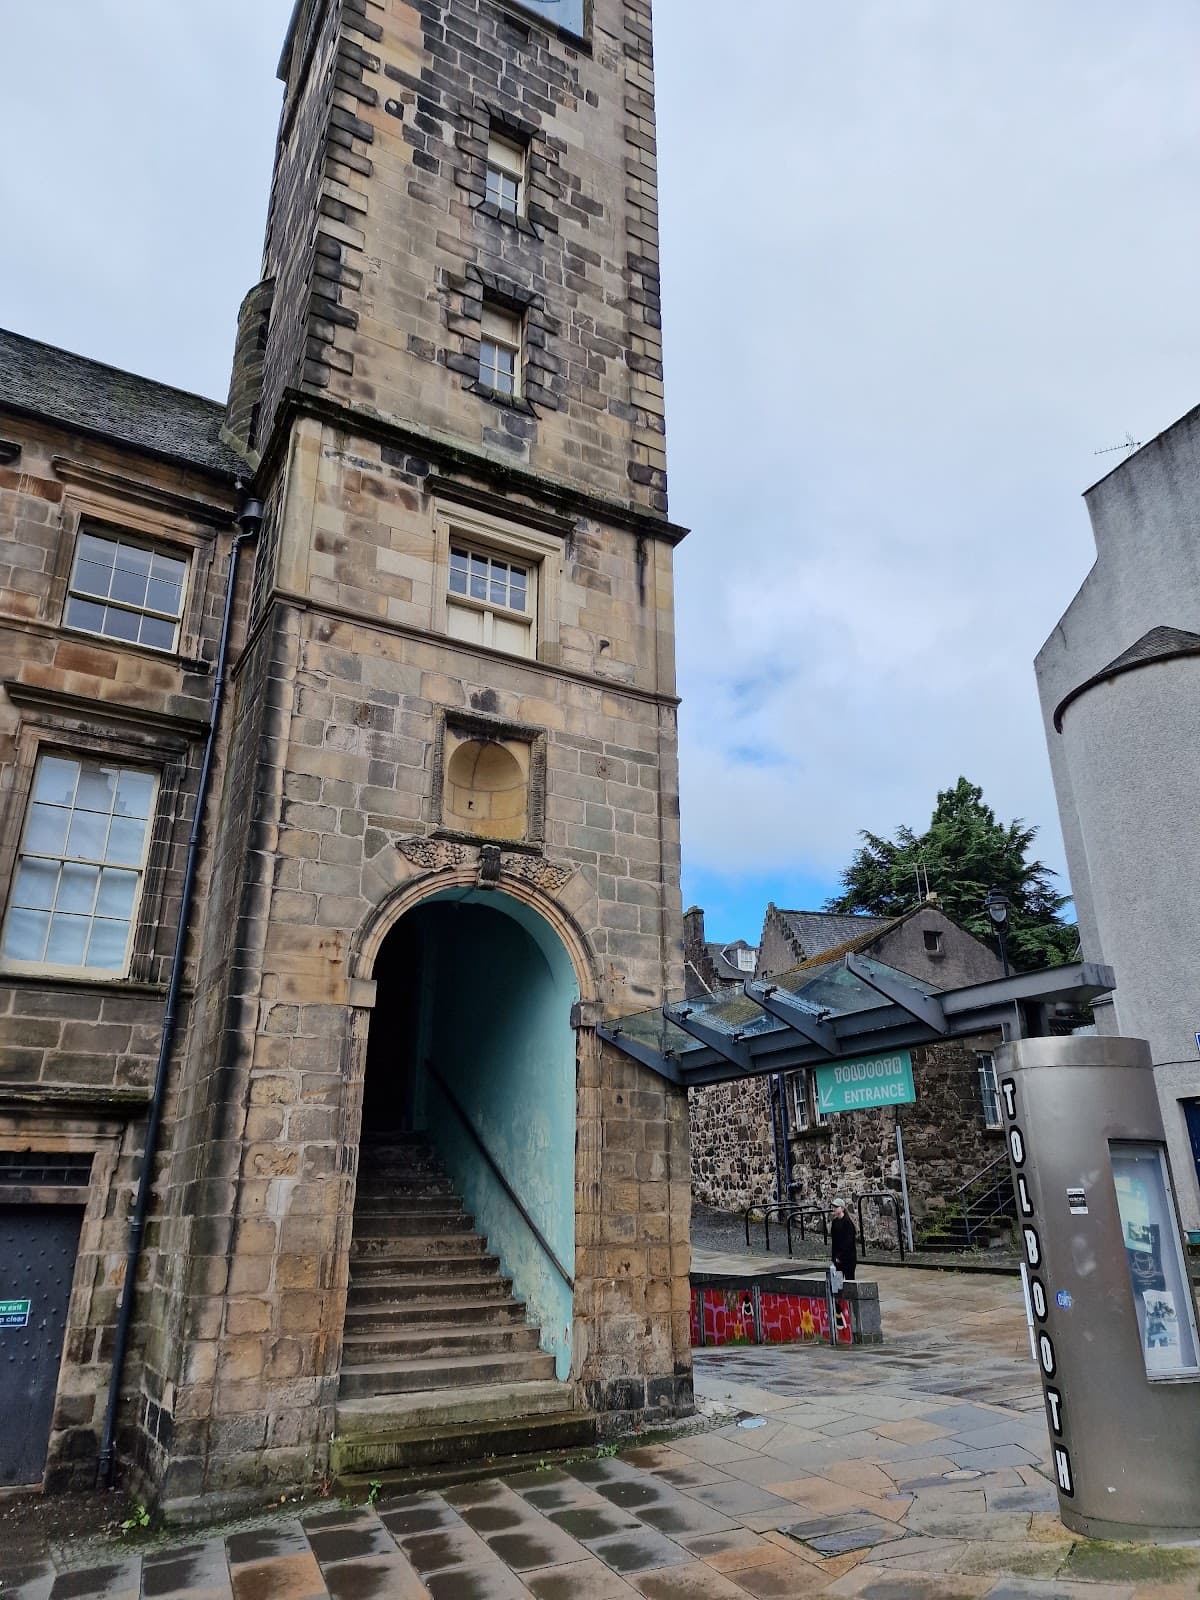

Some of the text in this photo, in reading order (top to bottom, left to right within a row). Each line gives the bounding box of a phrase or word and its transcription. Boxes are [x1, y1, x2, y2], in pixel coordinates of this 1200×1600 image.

[834, 1056, 902, 1084] TOLBOOTH
[844, 1083, 905, 1105] ENTRANCE
[1002, 1079, 1073, 1498] TOLBOOTH
[6, 1315, 25, 1323] clear
